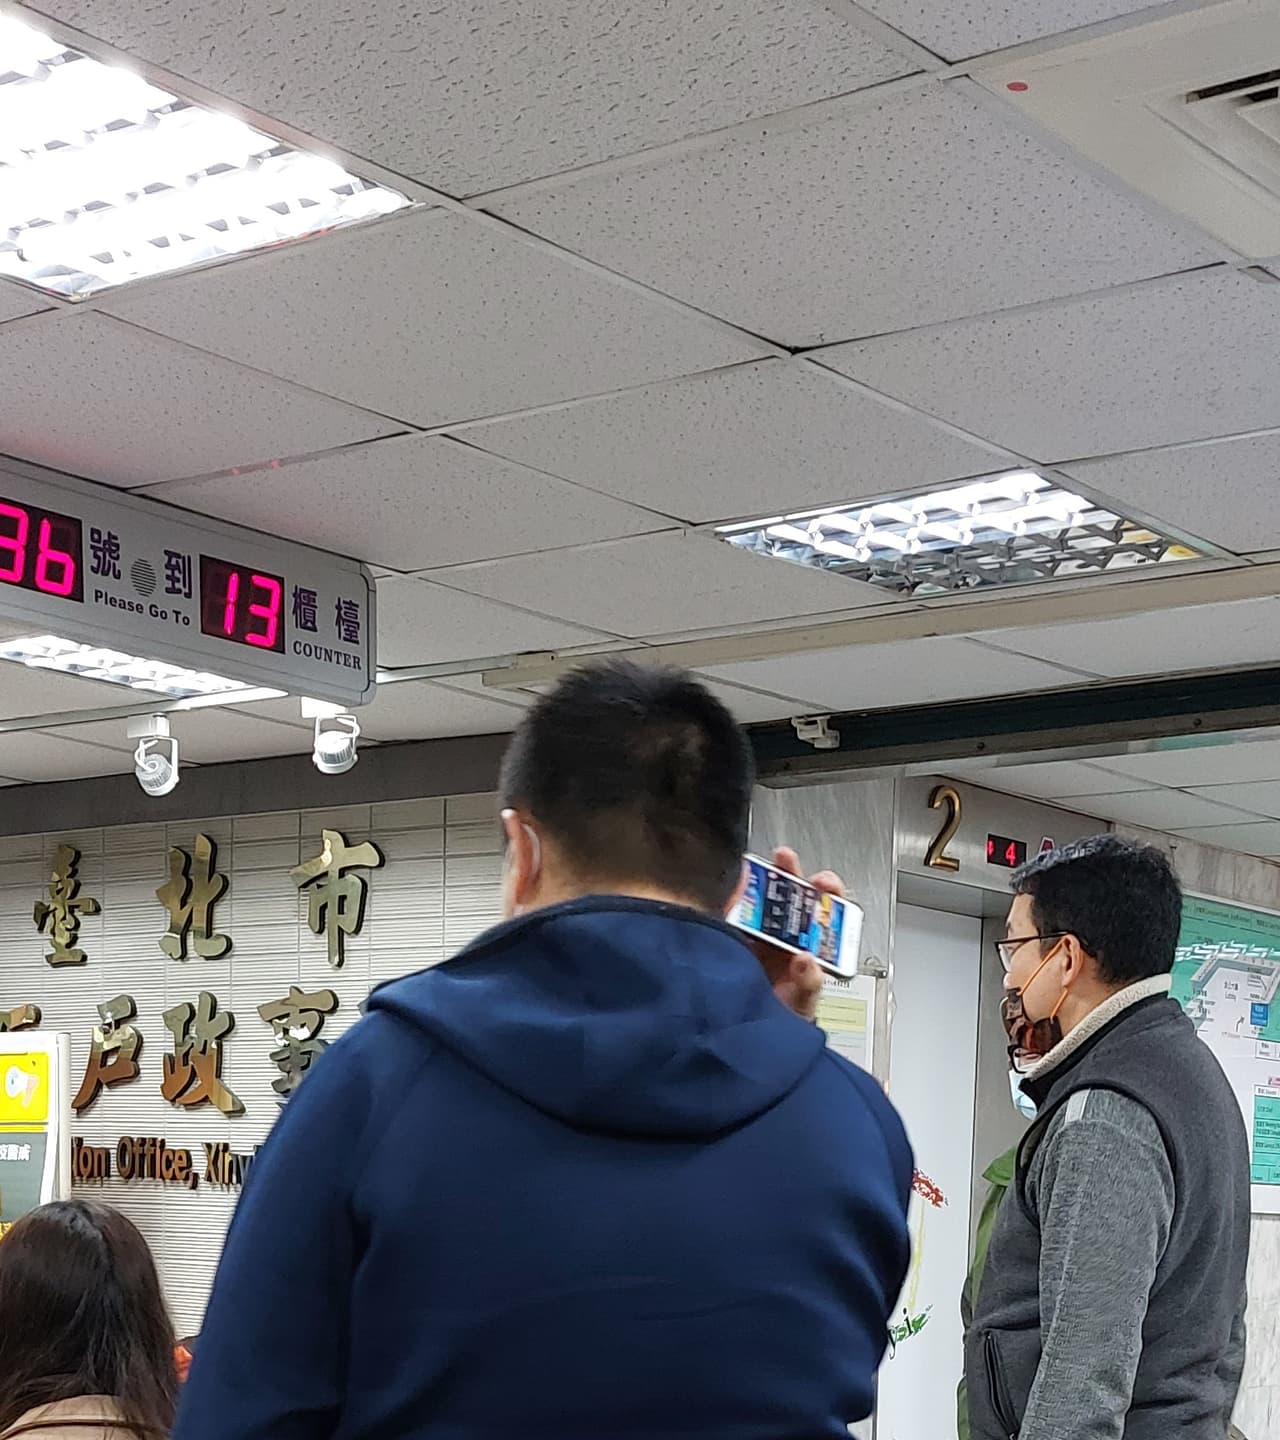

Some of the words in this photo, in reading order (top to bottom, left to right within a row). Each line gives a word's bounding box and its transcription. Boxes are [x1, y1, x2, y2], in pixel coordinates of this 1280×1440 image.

[89, 526, 122, 580] 號
[163, 549, 193, 600] 到
[223, 571, 281, 648] 13
[93, 589, 144, 615] Please
[147, 600, 169, 622] Go
[171, 609, 192, 628] To
[292, 640, 363, 672] COUNTER
[924, 784, 963, 872] 2
[1005, 841, 1017, 867] 4
[34, 828, 385, 968] 臺北市
[116, 1135, 200, 1190] Office,
